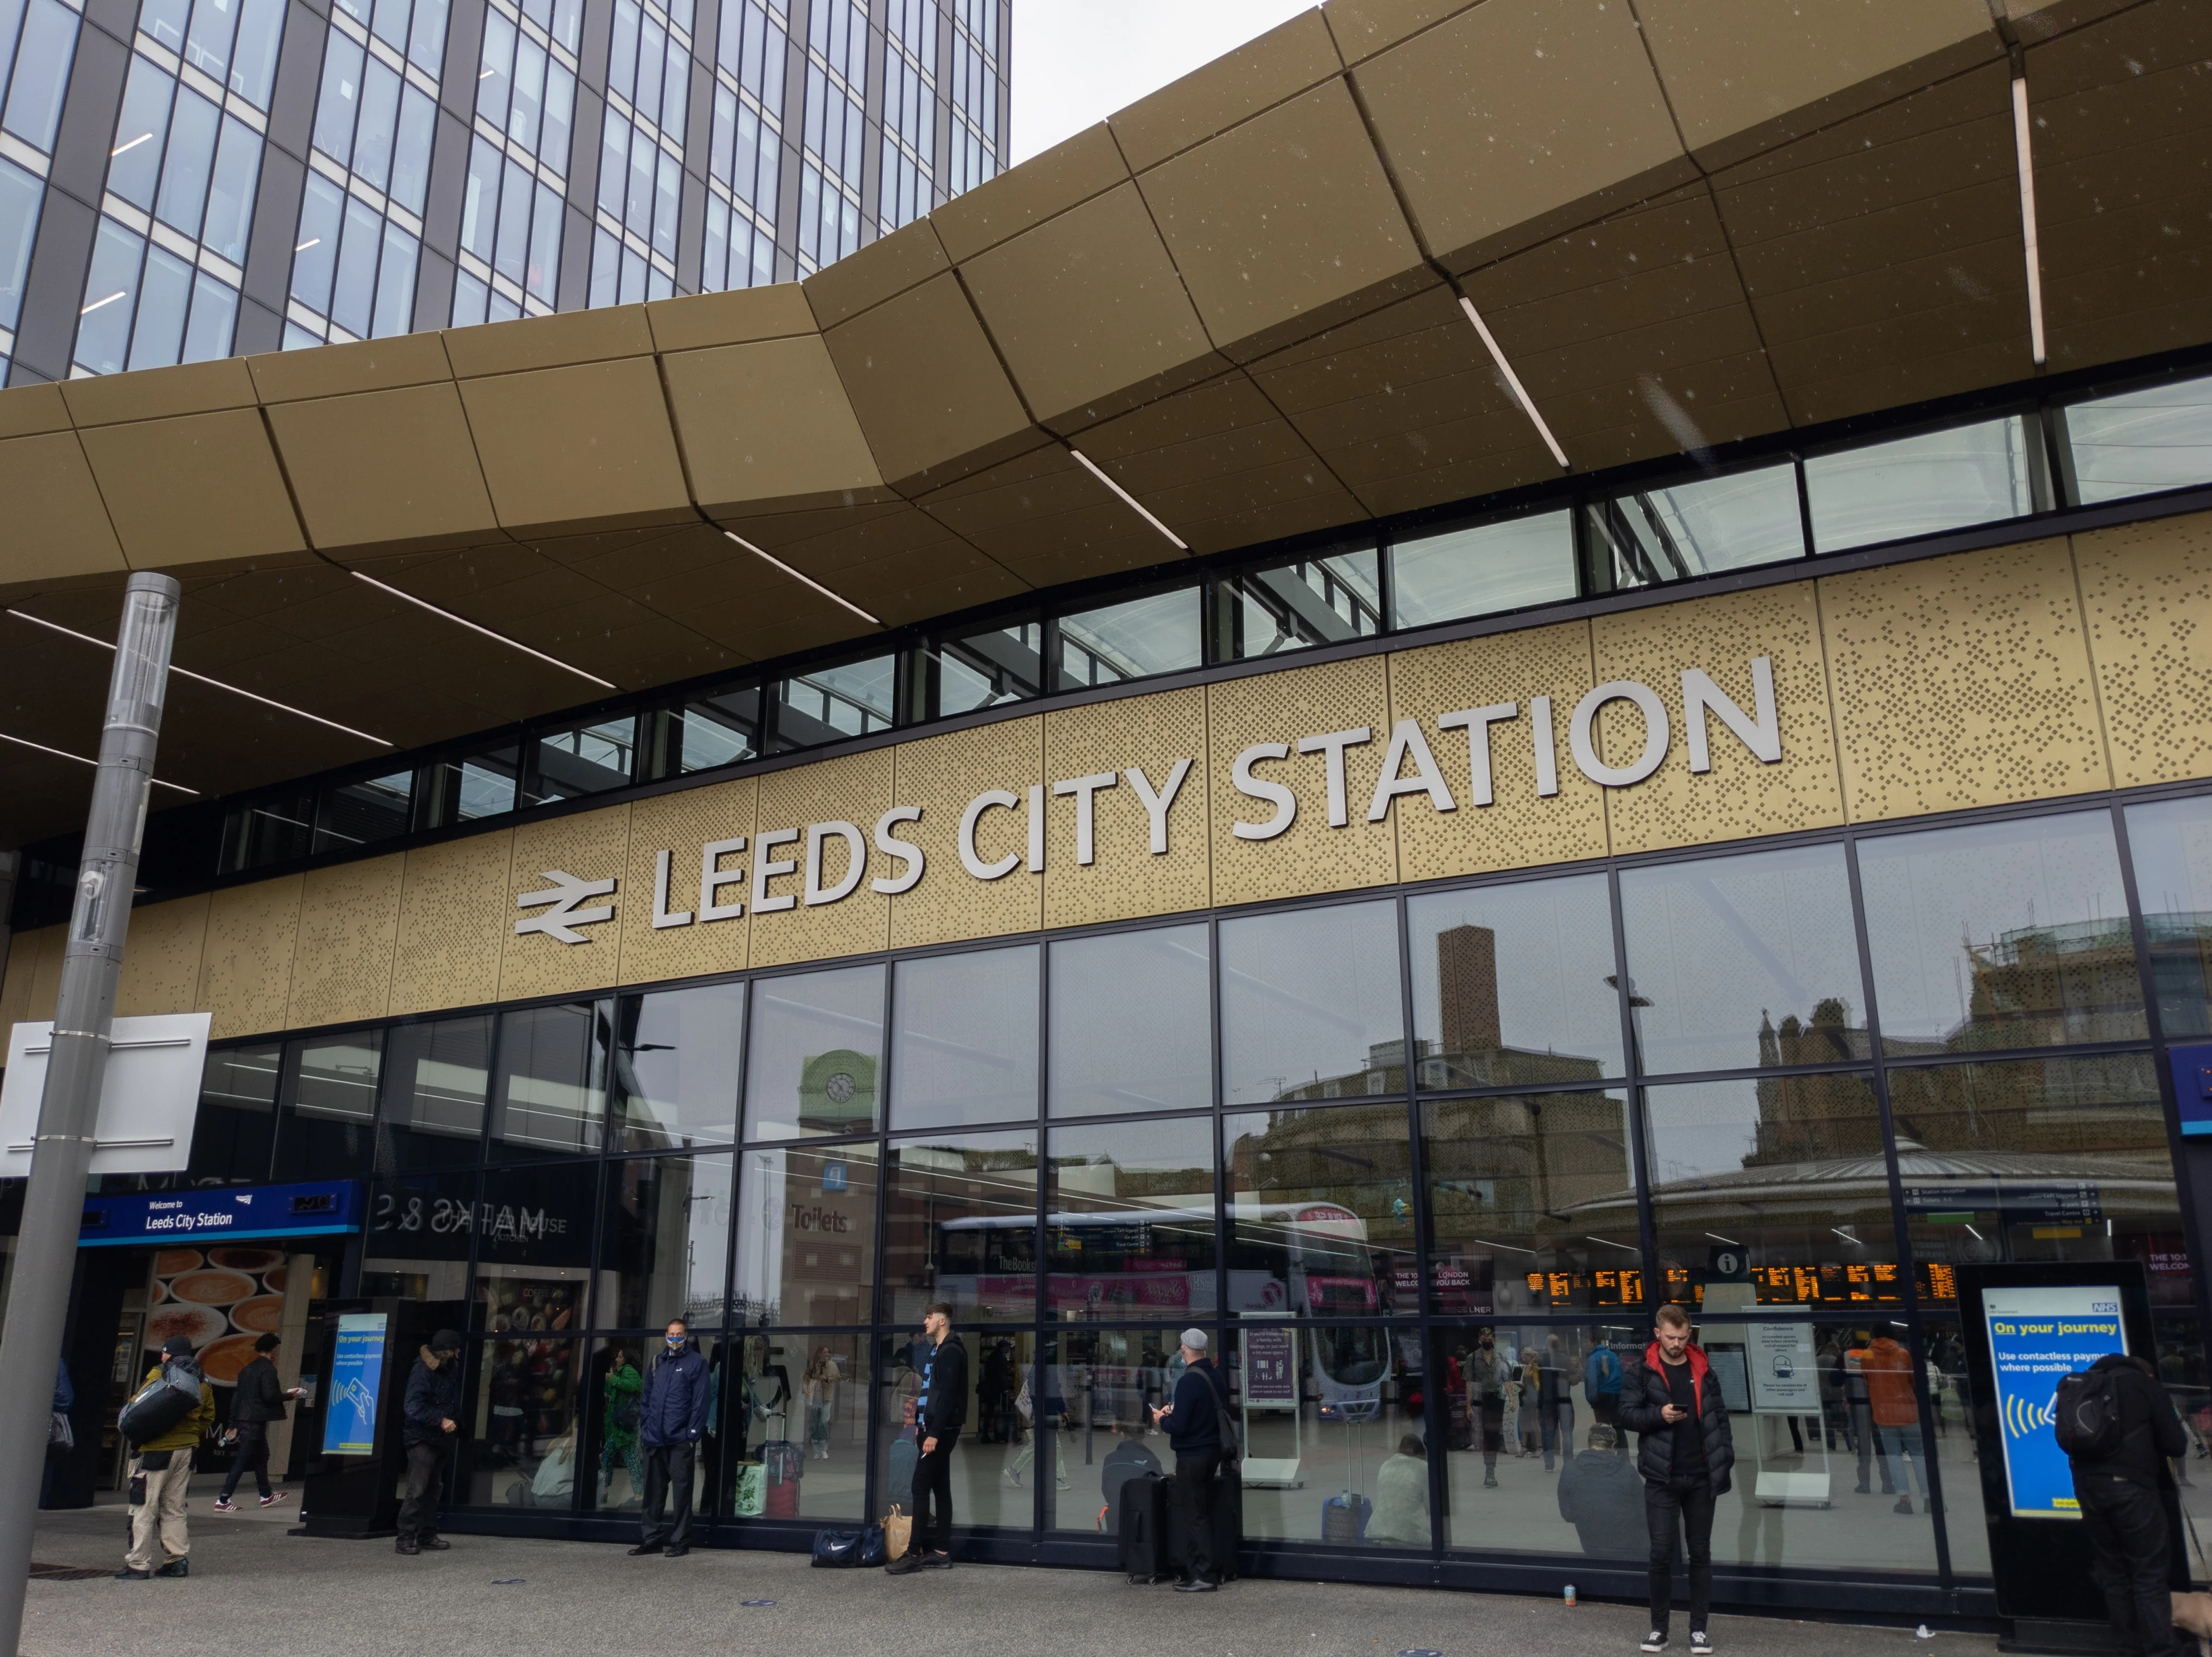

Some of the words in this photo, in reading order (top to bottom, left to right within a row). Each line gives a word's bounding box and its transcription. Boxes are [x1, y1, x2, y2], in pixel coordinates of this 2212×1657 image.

[652, 806, 926, 929] LEEDS
[958, 758, 1194, 880] CITY
[1231, 656, 1782, 839] STATION
[150, 1201, 175, 1210] Welcome
[146, 1215, 174, 1229] Leeds
[176, 1214, 195, 1230] City
[197, 1212, 232, 1226] Station
[790, 1204, 848, 1233] Toilets
[498, 1233, 529, 1243] KITCHEN
[523, 1288, 550, 1298] COFFEE
[1469, 1305, 1492, 1314] LNER
[2093, 1303, 2117, 1312] NHS
[1995, 1322, 2015, 1333] On
[2020, 1324, 2054, 1336] your
[2057, 1322, 2117, 1336] journey
[348, 1336, 361, 1344] your
[362, 1334, 385, 1344] journey
[2018, 1352, 2071, 1361] contactless
[2074, 1353, 2109, 1362] paym
[2000, 1363, 2030, 1372] where
[2033, 1363, 2072, 1373] possible
